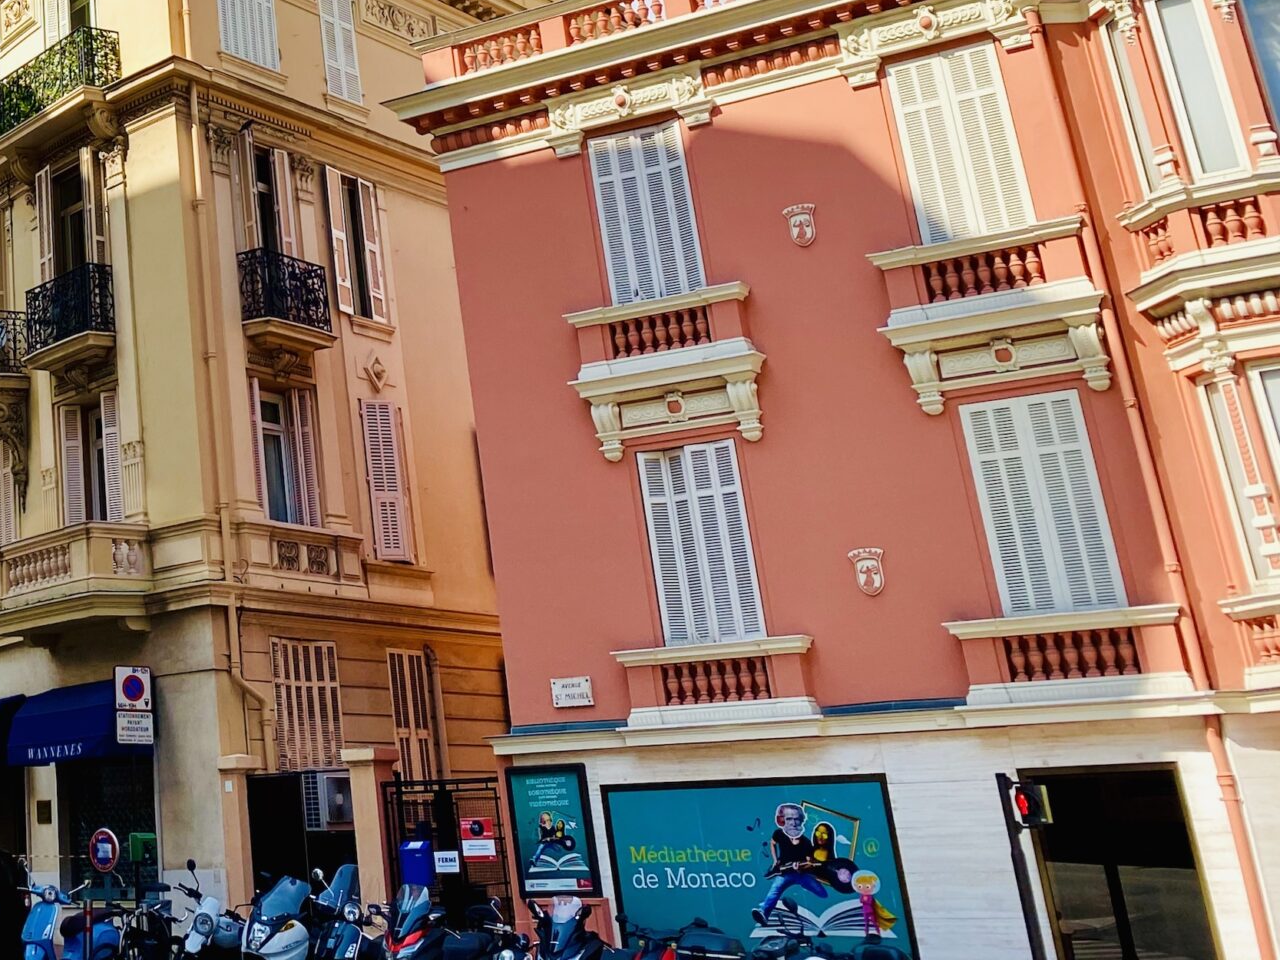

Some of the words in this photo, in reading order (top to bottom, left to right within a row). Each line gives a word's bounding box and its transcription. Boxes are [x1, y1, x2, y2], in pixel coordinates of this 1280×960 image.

[27, 742, 83, 760] WANNENES
[630, 843, 752, 866] Médiathèque
[632, 868, 659, 889] de
[665, 867, 756, 889] Monaco
